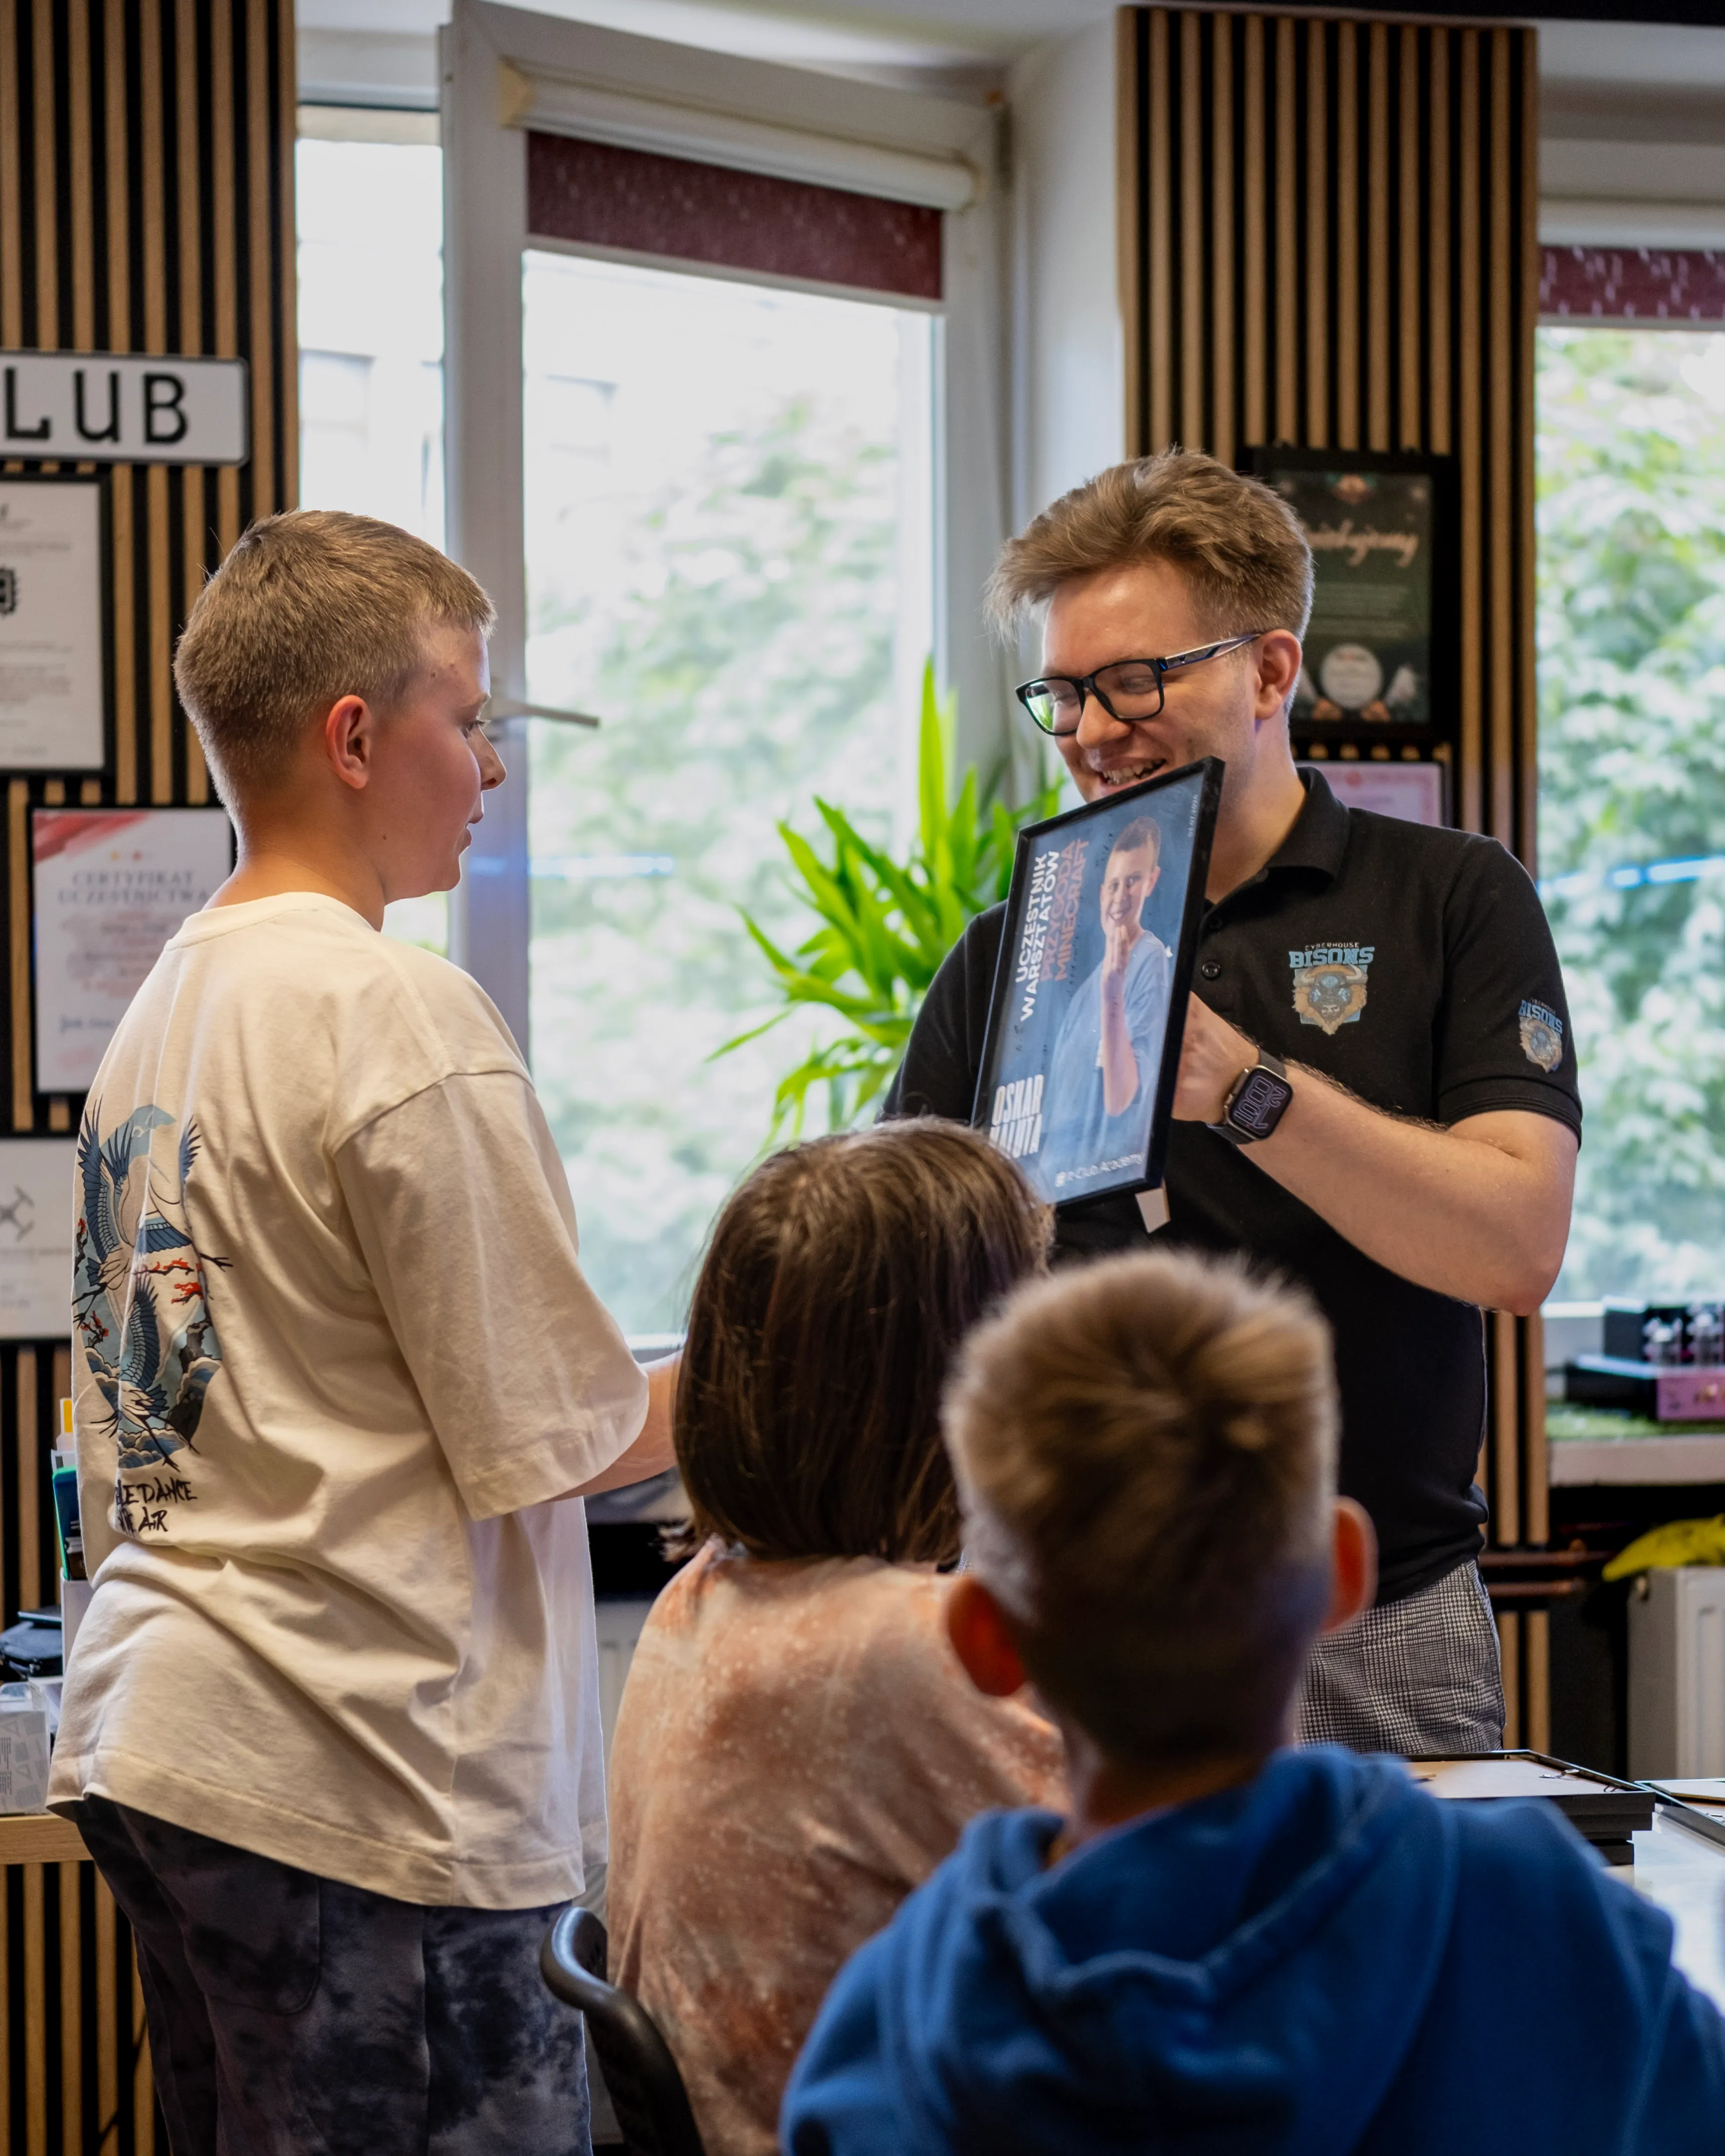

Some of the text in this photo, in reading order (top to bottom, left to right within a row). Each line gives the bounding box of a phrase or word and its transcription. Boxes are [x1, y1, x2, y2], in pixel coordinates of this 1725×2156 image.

[5, 366, 189, 445] LUB
[1015, 853, 1047, 983] UCZESTNIK
[1020, 851, 1059, 1022] WARSZTATÓW
[1040, 840, 1076, 981] PRZYGODA
[1054, 837, 1090, 981] MINECRAFT
[1288, 947, 1375, 968] BISONS
[1518, 999, 1563, 1034] BISONS
[992, 1073, 1044, 1126] OSKAR
